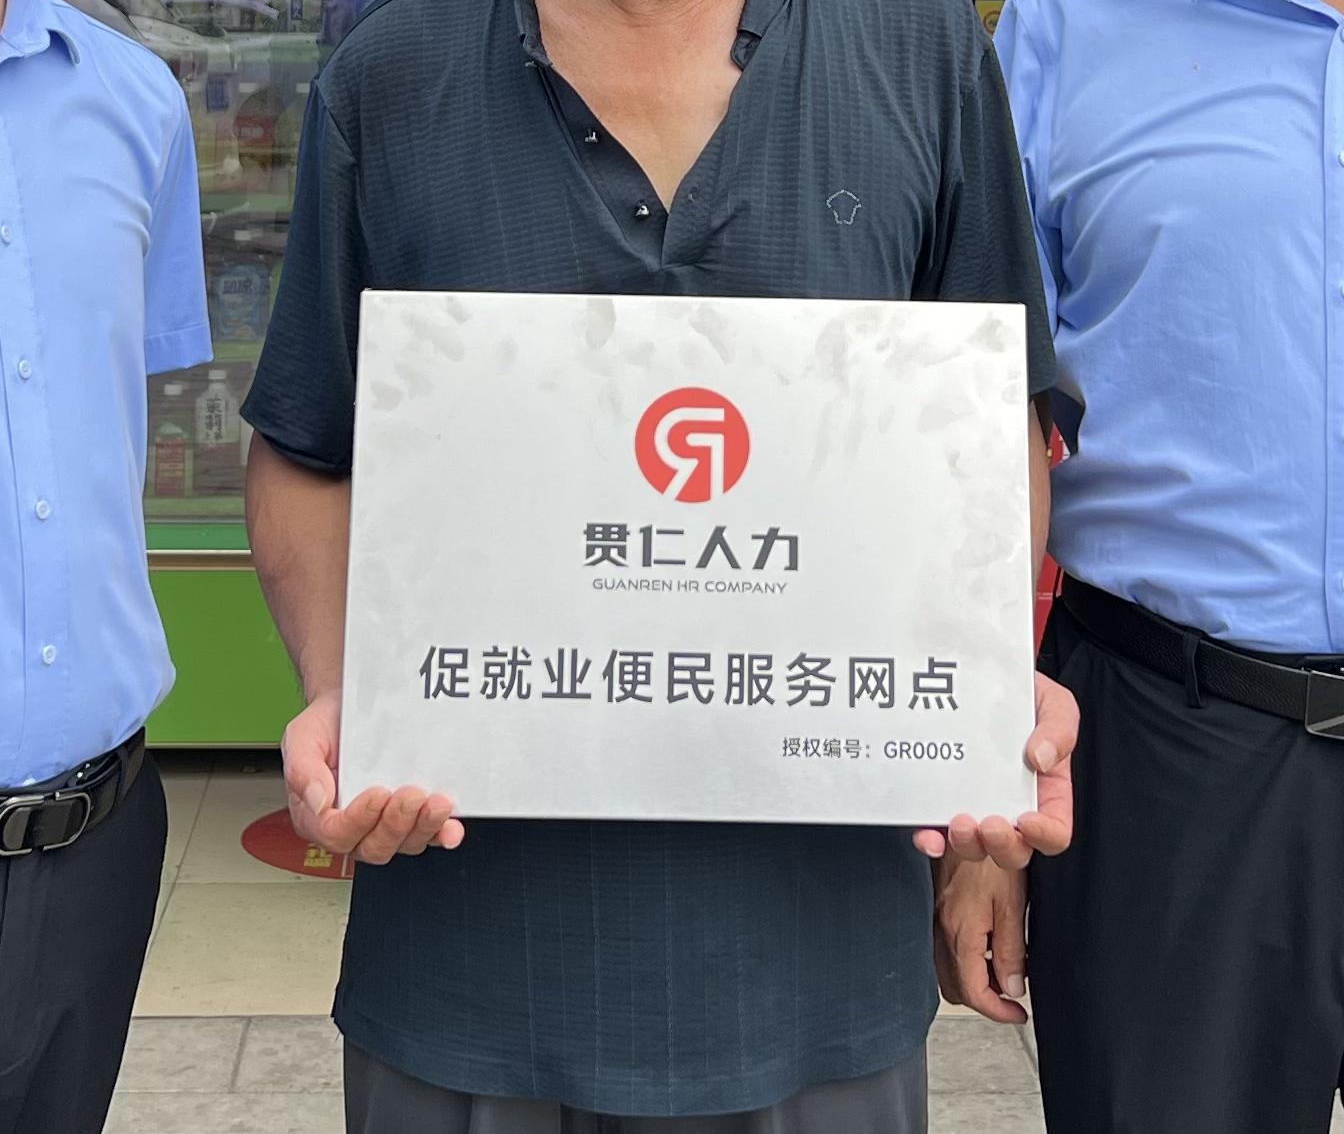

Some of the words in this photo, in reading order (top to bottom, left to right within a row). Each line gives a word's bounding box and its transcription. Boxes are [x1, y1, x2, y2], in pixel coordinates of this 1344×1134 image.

[583, 522, 800, 572] 贯仁人力
[592, 577, 673, 592] GUANREN
[677, 579, 700, 593] HR
[704, 580, 788, 595] COMPANY
[419, 644, 960, 712] 促就业便民服务网点
